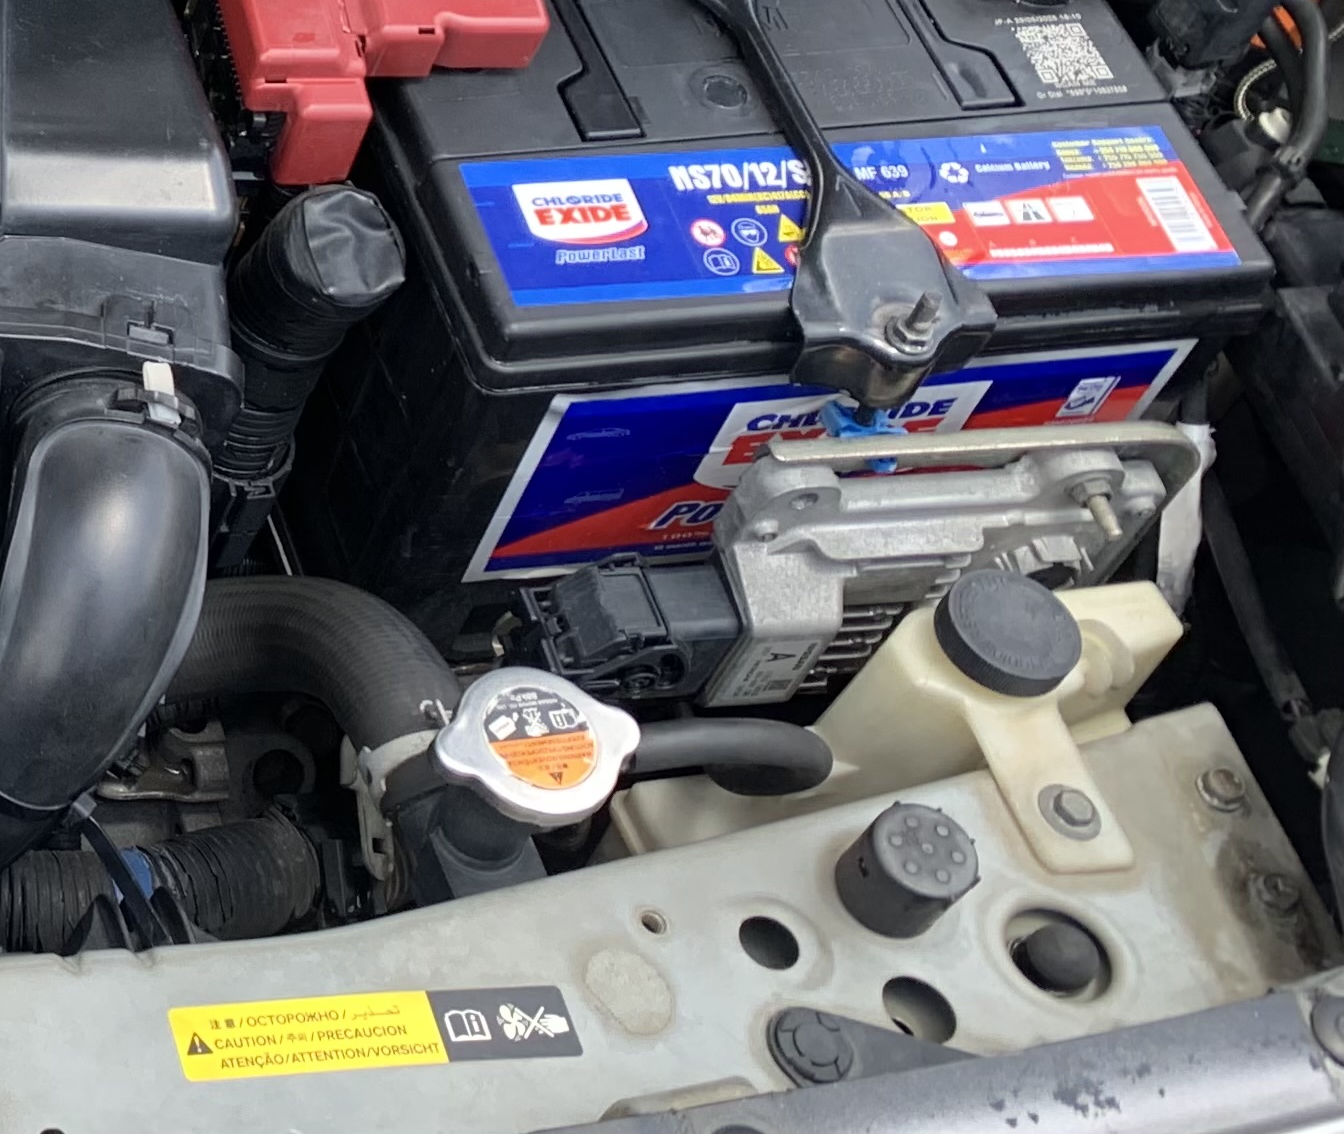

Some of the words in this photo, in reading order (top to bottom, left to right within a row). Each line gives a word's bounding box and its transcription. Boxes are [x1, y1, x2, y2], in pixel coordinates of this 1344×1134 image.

[668, 159, 812, 192] NS70/12/S
[854, 166, 877, 181] MF
[880, 164, 909, 179] 639
[975, 161, 1012, 174] Calcium
[1013, 159, 1051, 174] Battery
[532, 192, 624, 207] CHLORIDE
[533, 204, 631, 226] EXIDE
[555, 245, 646, 265] PowerLast
